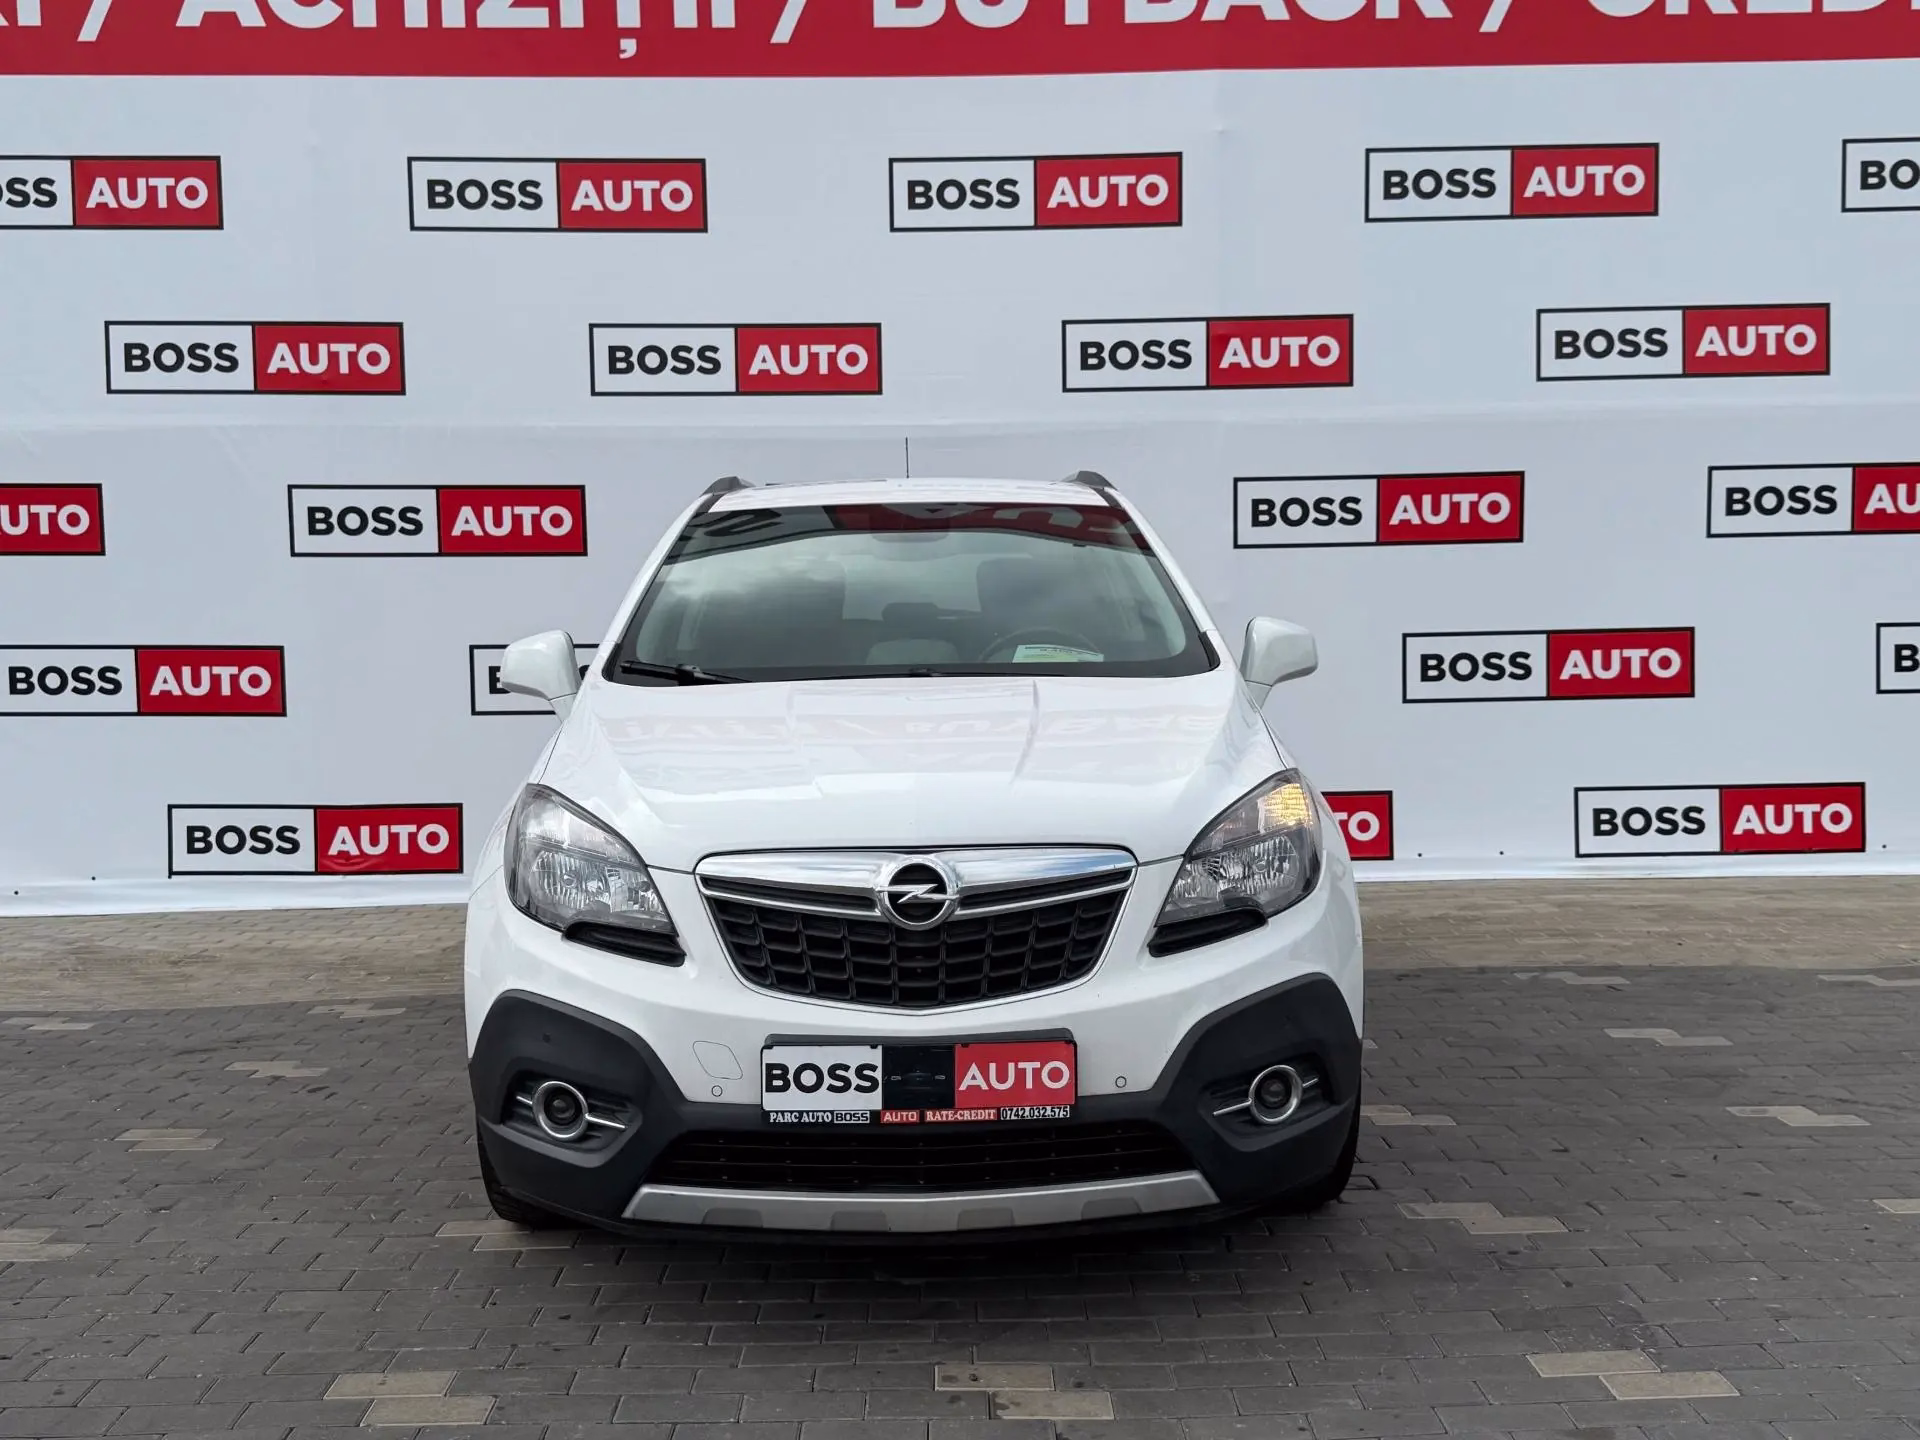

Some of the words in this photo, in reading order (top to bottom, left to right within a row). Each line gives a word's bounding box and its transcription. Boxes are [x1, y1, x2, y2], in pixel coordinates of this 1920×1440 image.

[1384, 168, 1496, 200] BOSS
[1524, 165, 1644, 197] AUTO
[1860, 159, 1920, 190] BO
[0, 177, 57, 208] SS
[86, 177, 208, 209] AUTO
[427, 179, 542, 210] BOSS
[572, 180, 692, 211] AUTO
[908, 179, 1019, 209] BOSS
[1048, 175, 1168, 208] AUTO
[124, 342, 239, 373] BOSS
[268, 343, 390, 374] AUTO
[1081, 340, 1191, 370] BOSS
[1220, 336, 1339, 368] AUTO
[1555, 328, 1667, 359] BOSS
[1696, 325, 1816, 356] AUTO
[608, 345, 721, 375] BOSS
[749, 344, 868, 375] AUTO
[1252, 497, 1362, 527] BOSS
[1390, 493, 1510, 524] AUTO
[1726, 485, 1837, 516] BOSS
[0, 504, 90, 536] UTO
[308, 506, 423, 536] BOSS
[452, 506, 572, 536] AUTO
[1421, 652, 1532, 682] BOSS
[1560, 648, 1680, 679] AUTO
[9, 666, 122, 695] BOSS
[150, 666, 271, 697] AUTO
[1593, 805, 1705, 836] BOSS
[1734, 803, 1852, 834] AUTO
[187, 825, 300, 855] BOSS
[329, 824, 449, 855] AUTO
[765, 1063, 879, 1093] BOSS
[958, 1061, 1069, 1090] AUTO
[769, 1112, 799, 1123] PARC
[801, 1112, 832, 1123] AUTO
[835, 1112, 868, 1122] BOSS
[883, 1111, 917, 1122] AUTO
[926, 1109, 996, 1121] RATE-CREDIT
[1001, 1106, 1069, 1120] 0742.032.575
